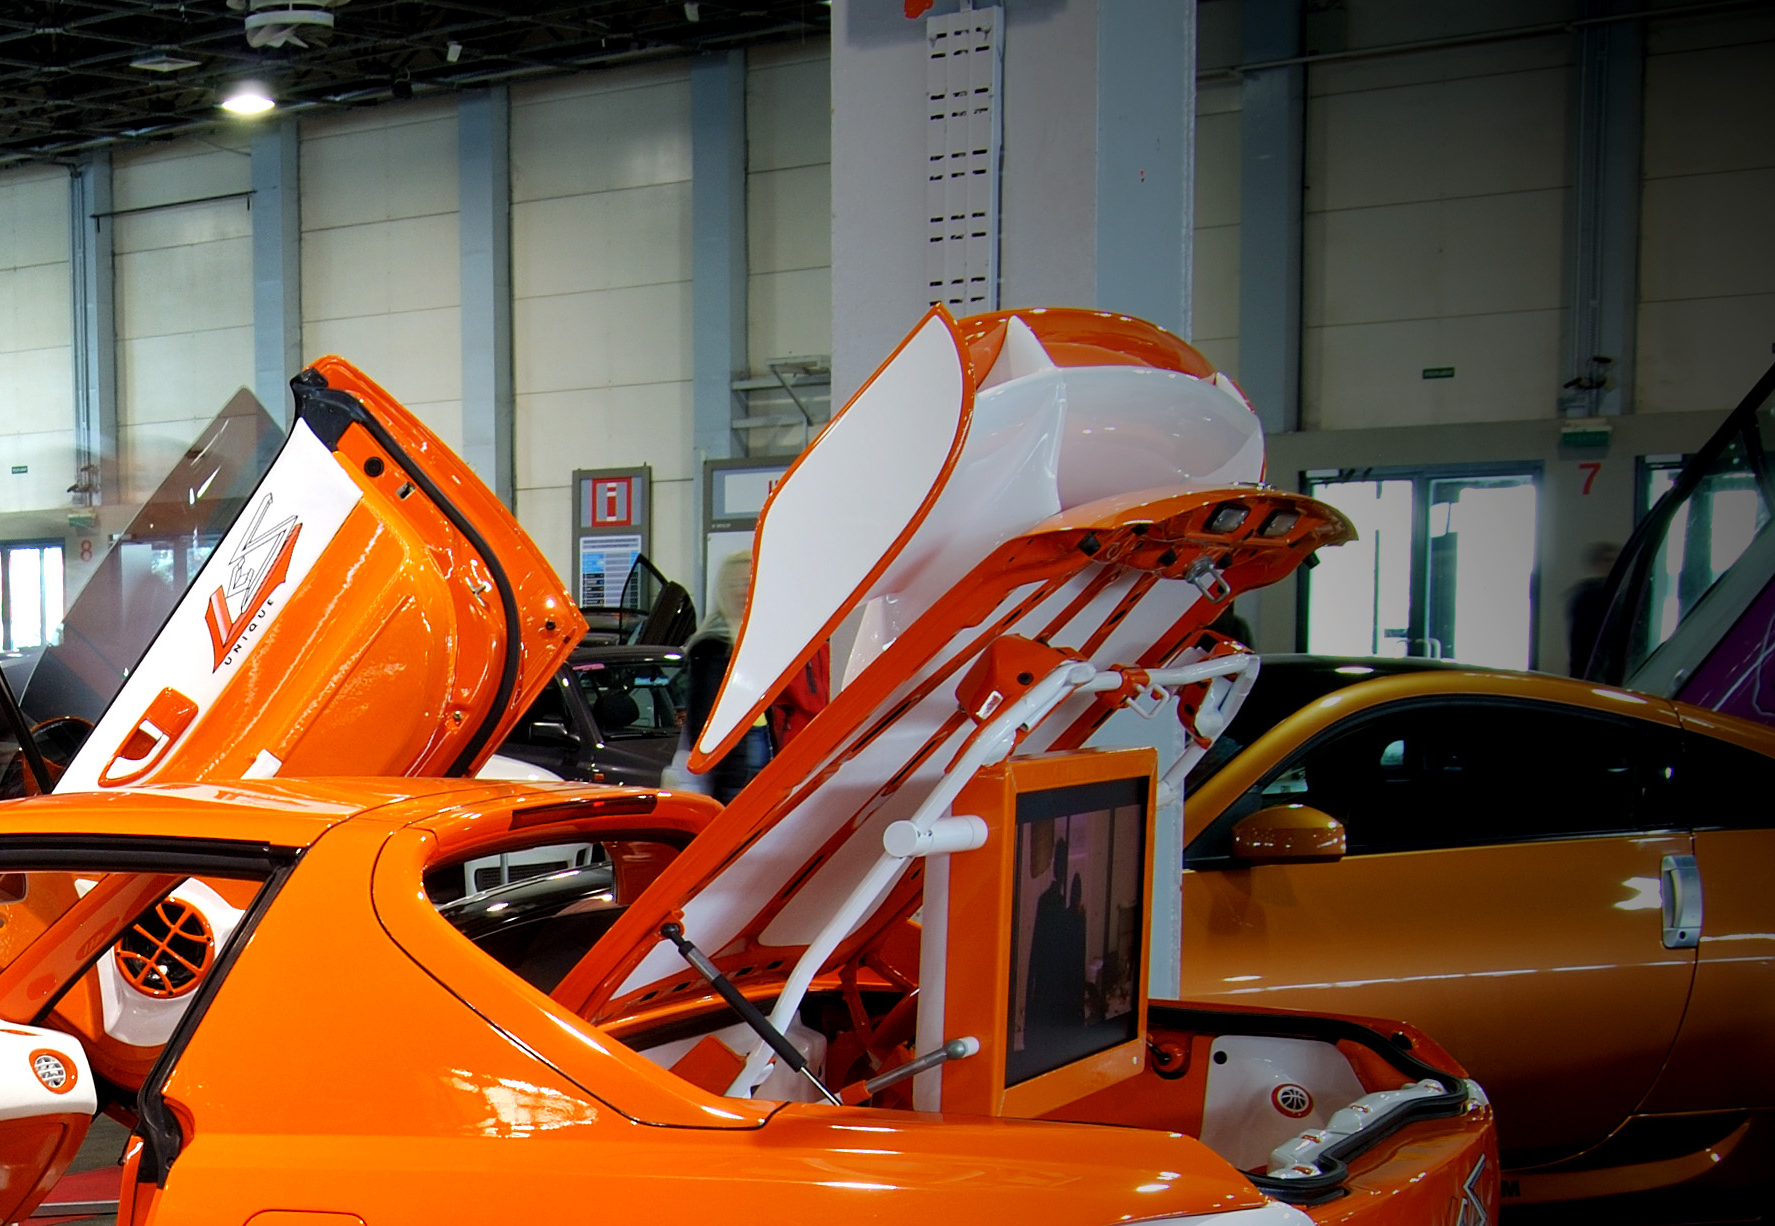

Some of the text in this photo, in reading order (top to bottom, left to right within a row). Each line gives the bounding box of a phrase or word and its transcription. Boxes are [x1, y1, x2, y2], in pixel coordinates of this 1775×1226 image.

[1577, 462, 1602, 496] 7
[80, 538, 93, 562] 8
[224, 598, 275, 666] UNIQUE
